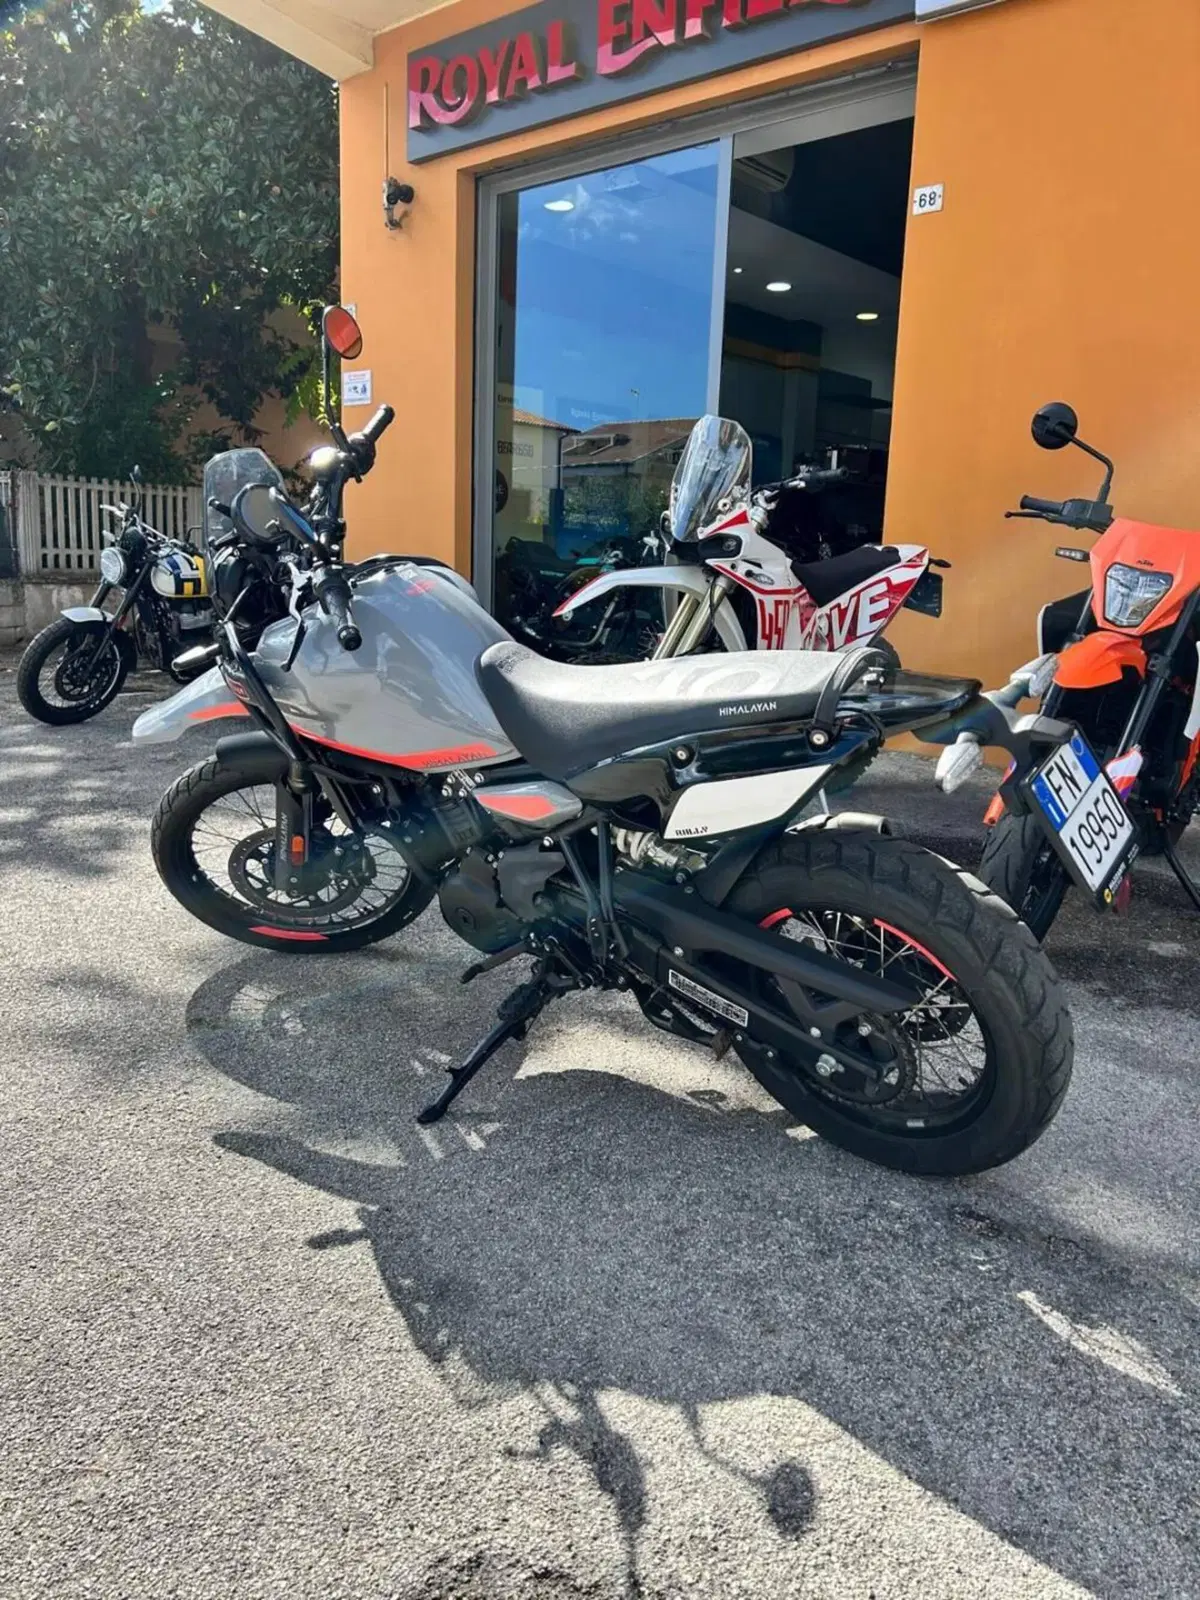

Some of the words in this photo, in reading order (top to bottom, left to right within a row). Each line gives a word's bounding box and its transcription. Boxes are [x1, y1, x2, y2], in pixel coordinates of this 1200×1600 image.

[409, 20, 577, 129] ROYAL
[919, 190, 937, 208] 68
[719, 701, 777, 716] HIMALAYAN
[1045, 754, 1082, 813] FN
[1070, 788, 1125, 876] 19950
